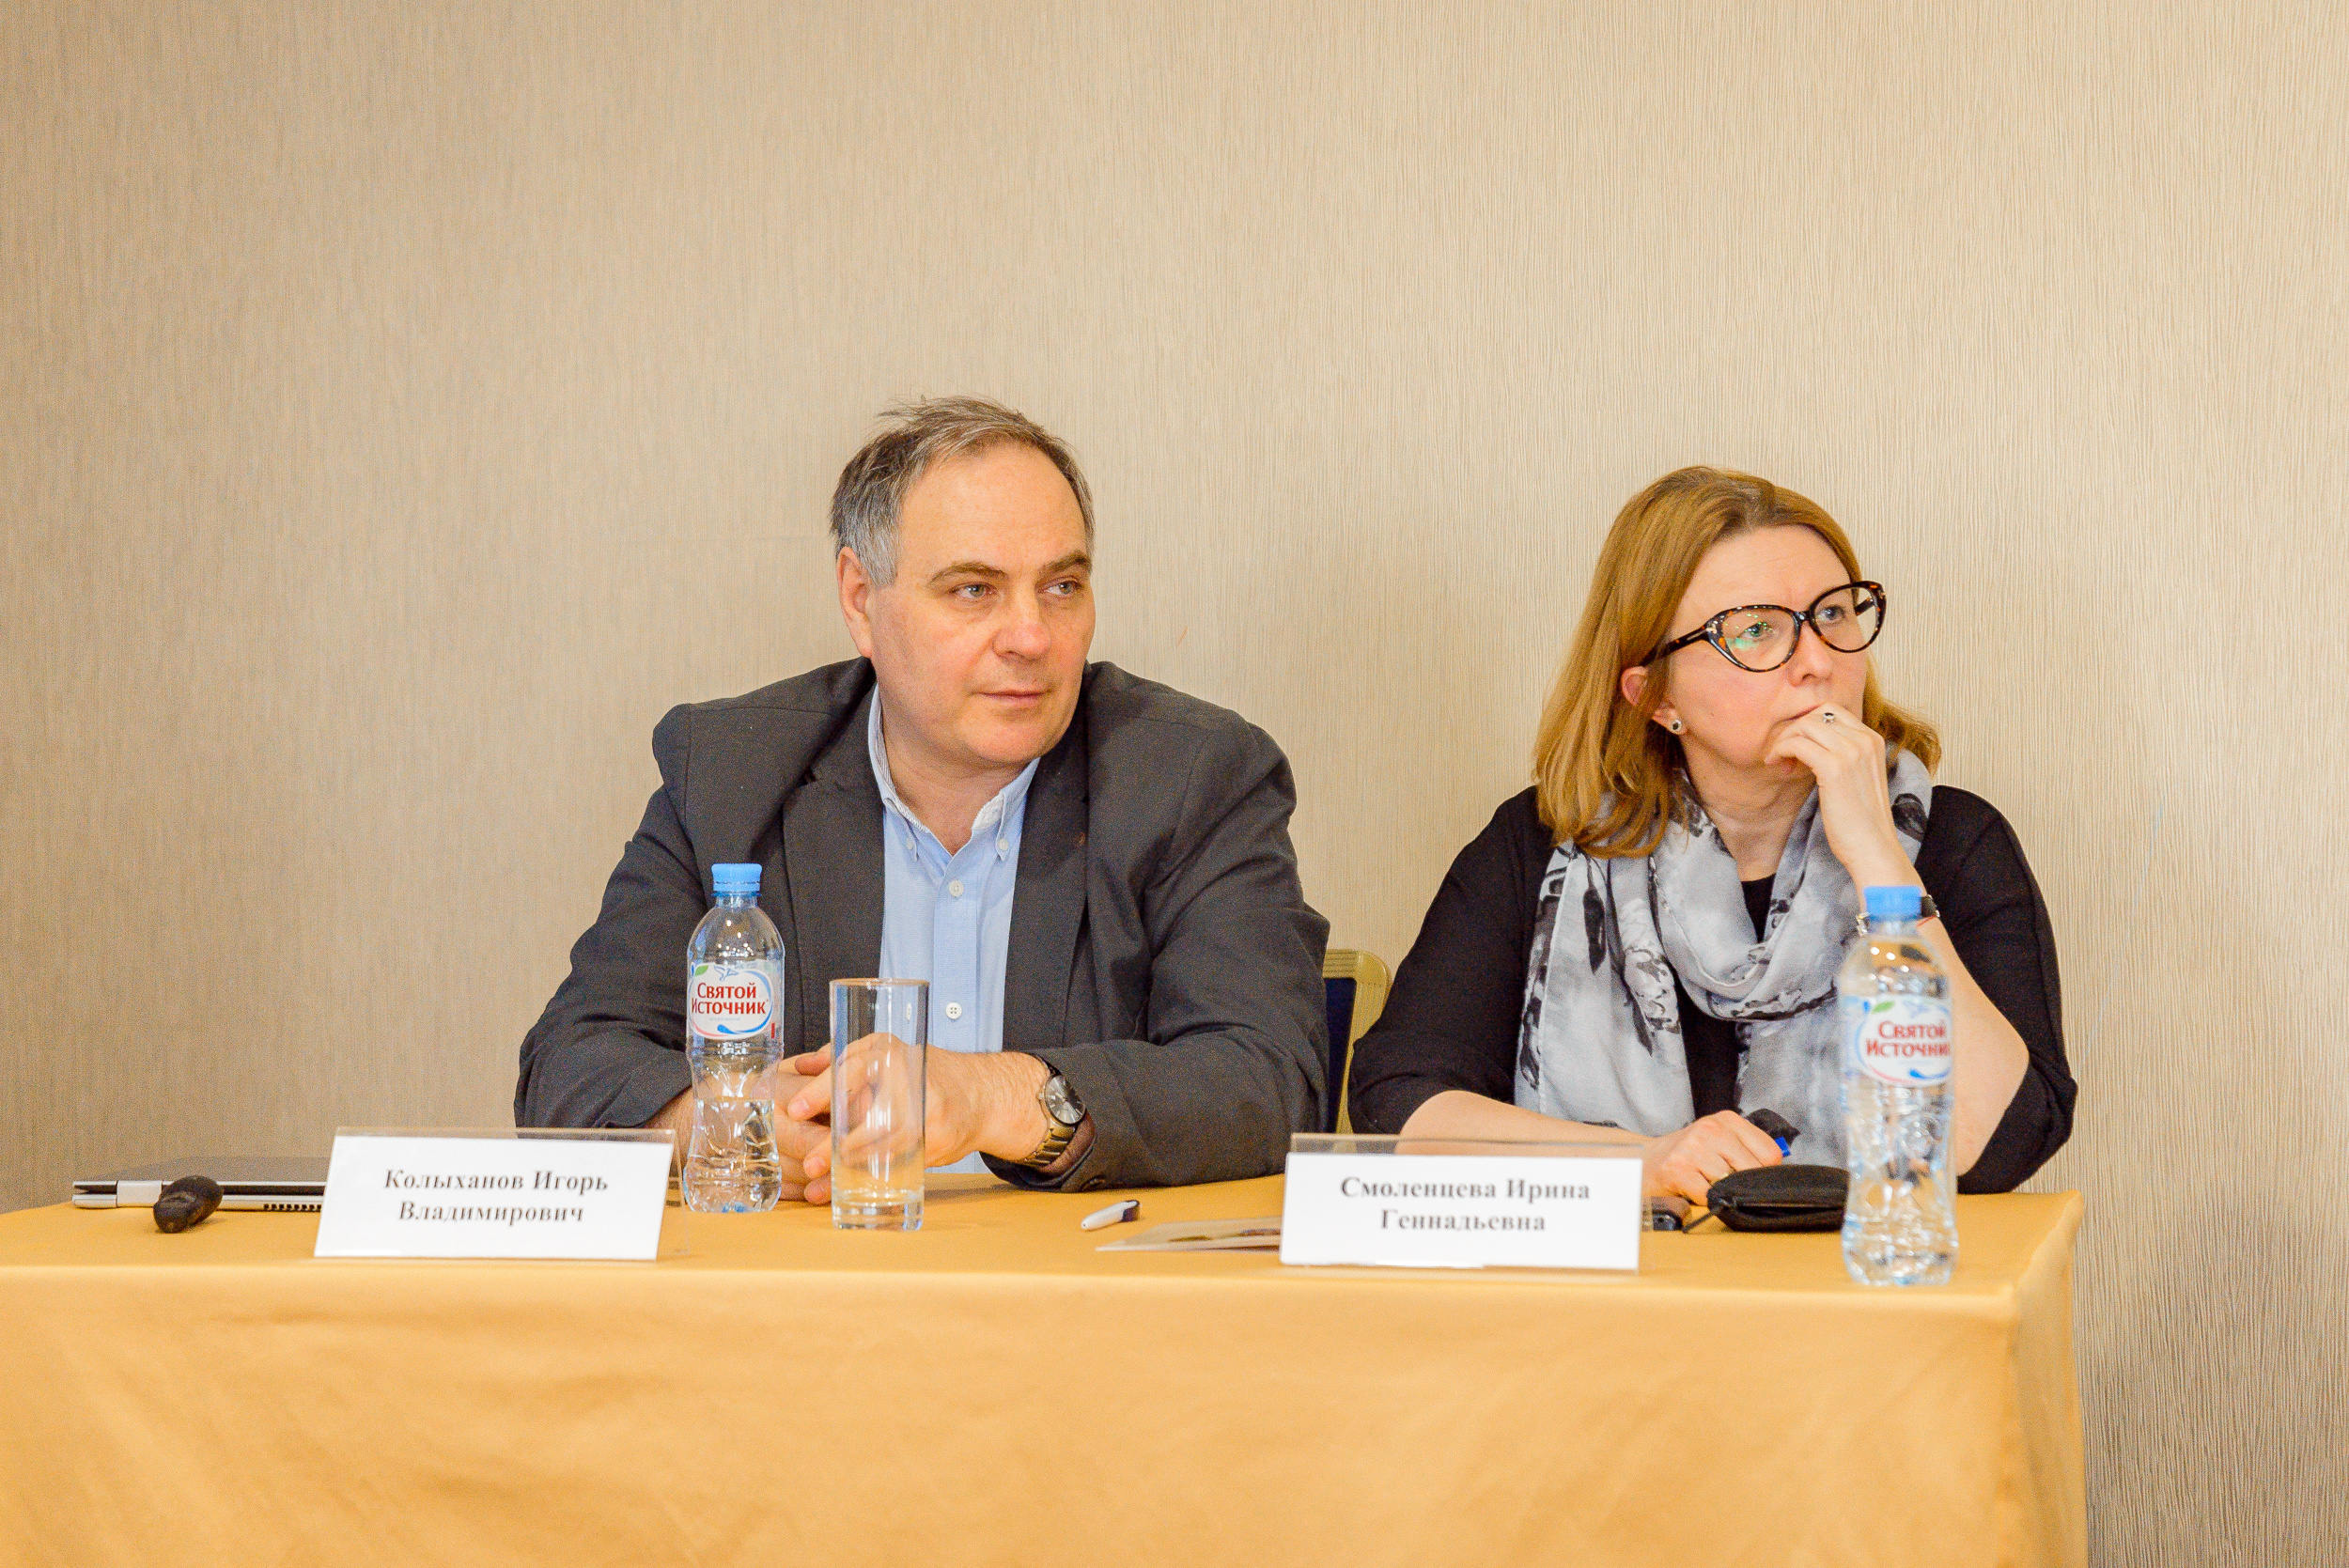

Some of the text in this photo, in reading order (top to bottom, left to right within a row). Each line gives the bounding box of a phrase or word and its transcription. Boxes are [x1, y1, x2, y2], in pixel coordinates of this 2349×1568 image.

[697, 982, 756, 999] Святой
[692, 998, 767, 1015] Источник
[1878, 1020, 1946, 1039] Святой
[384, 1170, 609, 1196] Колыханов Игорь
[1341, 1177, 1591, 1203] Смоленцева Ирина
[399, 1202, 583, 1227] Владимирович
[1381, 1209, 1546, 1231] Геннадьевна
